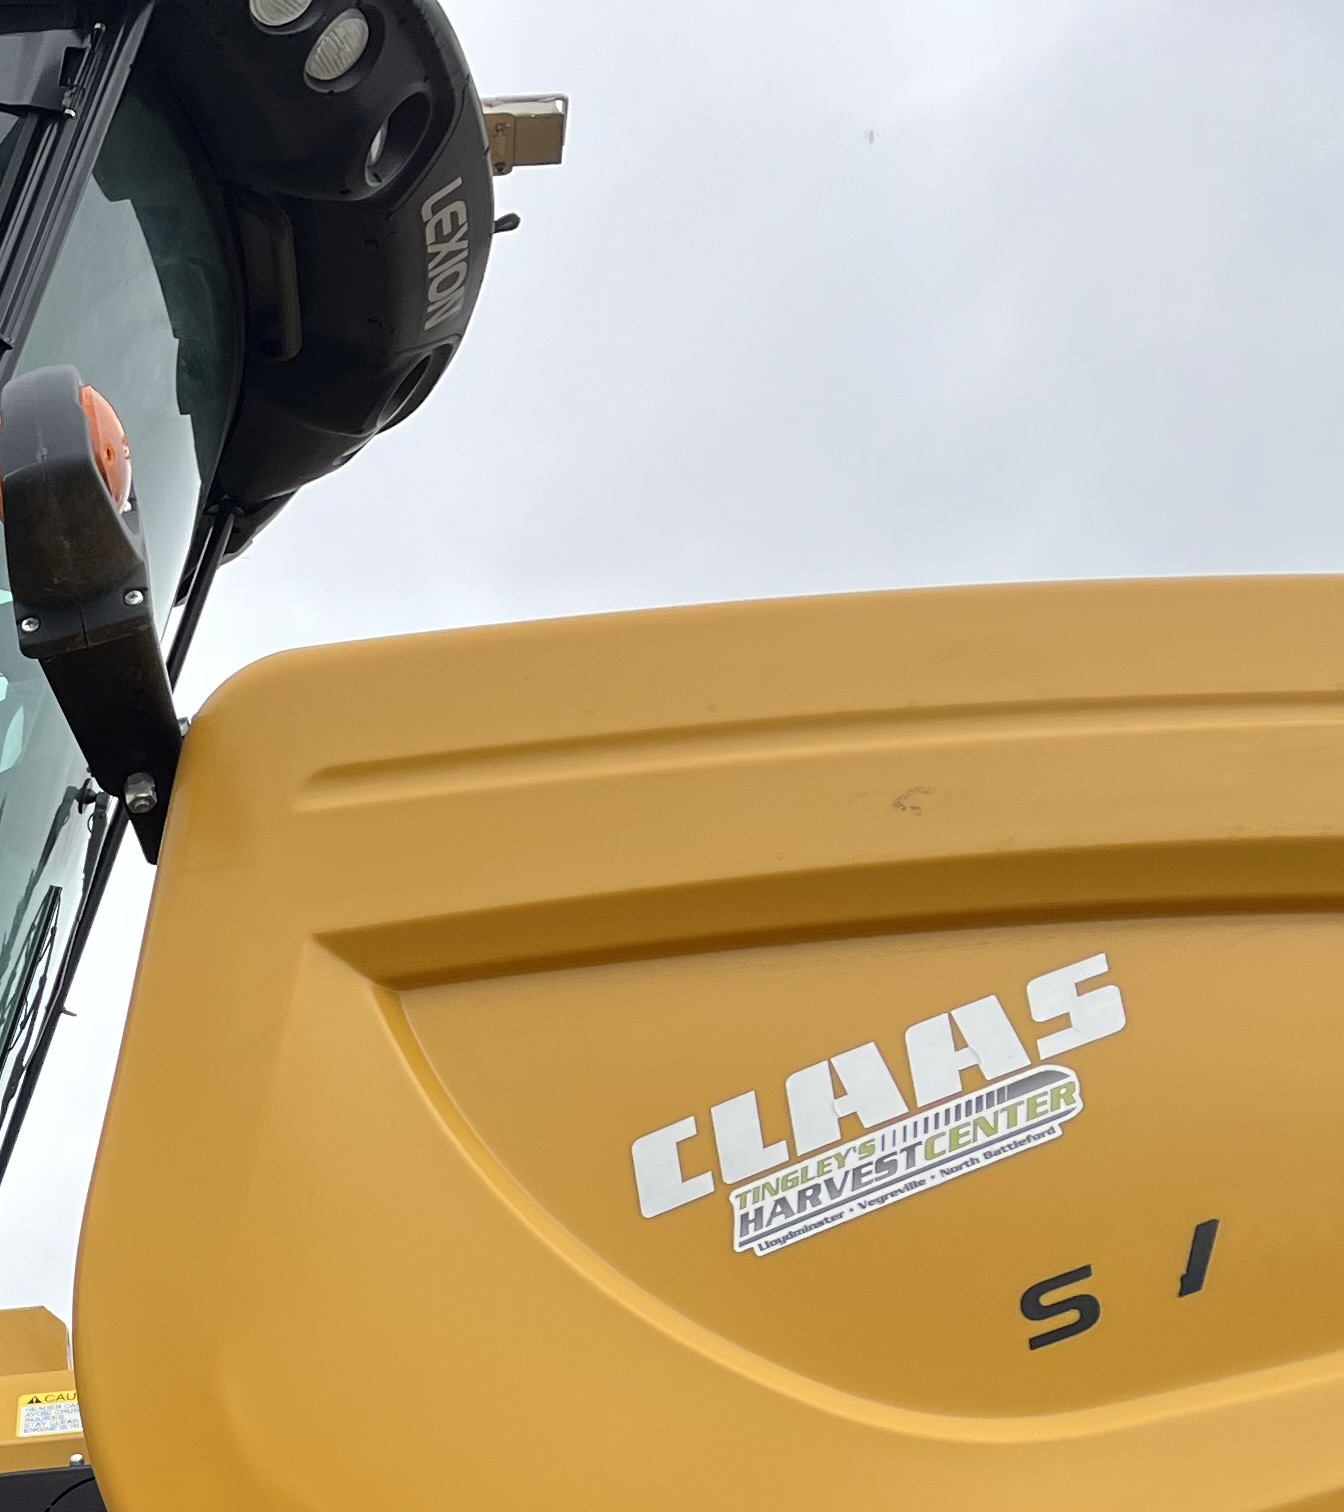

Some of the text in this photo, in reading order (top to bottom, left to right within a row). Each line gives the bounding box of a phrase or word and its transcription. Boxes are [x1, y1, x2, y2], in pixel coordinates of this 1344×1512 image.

[420, 176, 469, 331] LEXION
[631, 952, 1127, 1219] CLAAS
[735, 1137, 876, 1211] TINGLEY'S
[757, 1125, 1057, 1252] Lloydminster Vegreville North Battleford
[1020, 1263, 1101, 1351] S
[44, 1392, 77, 1403] CAU
